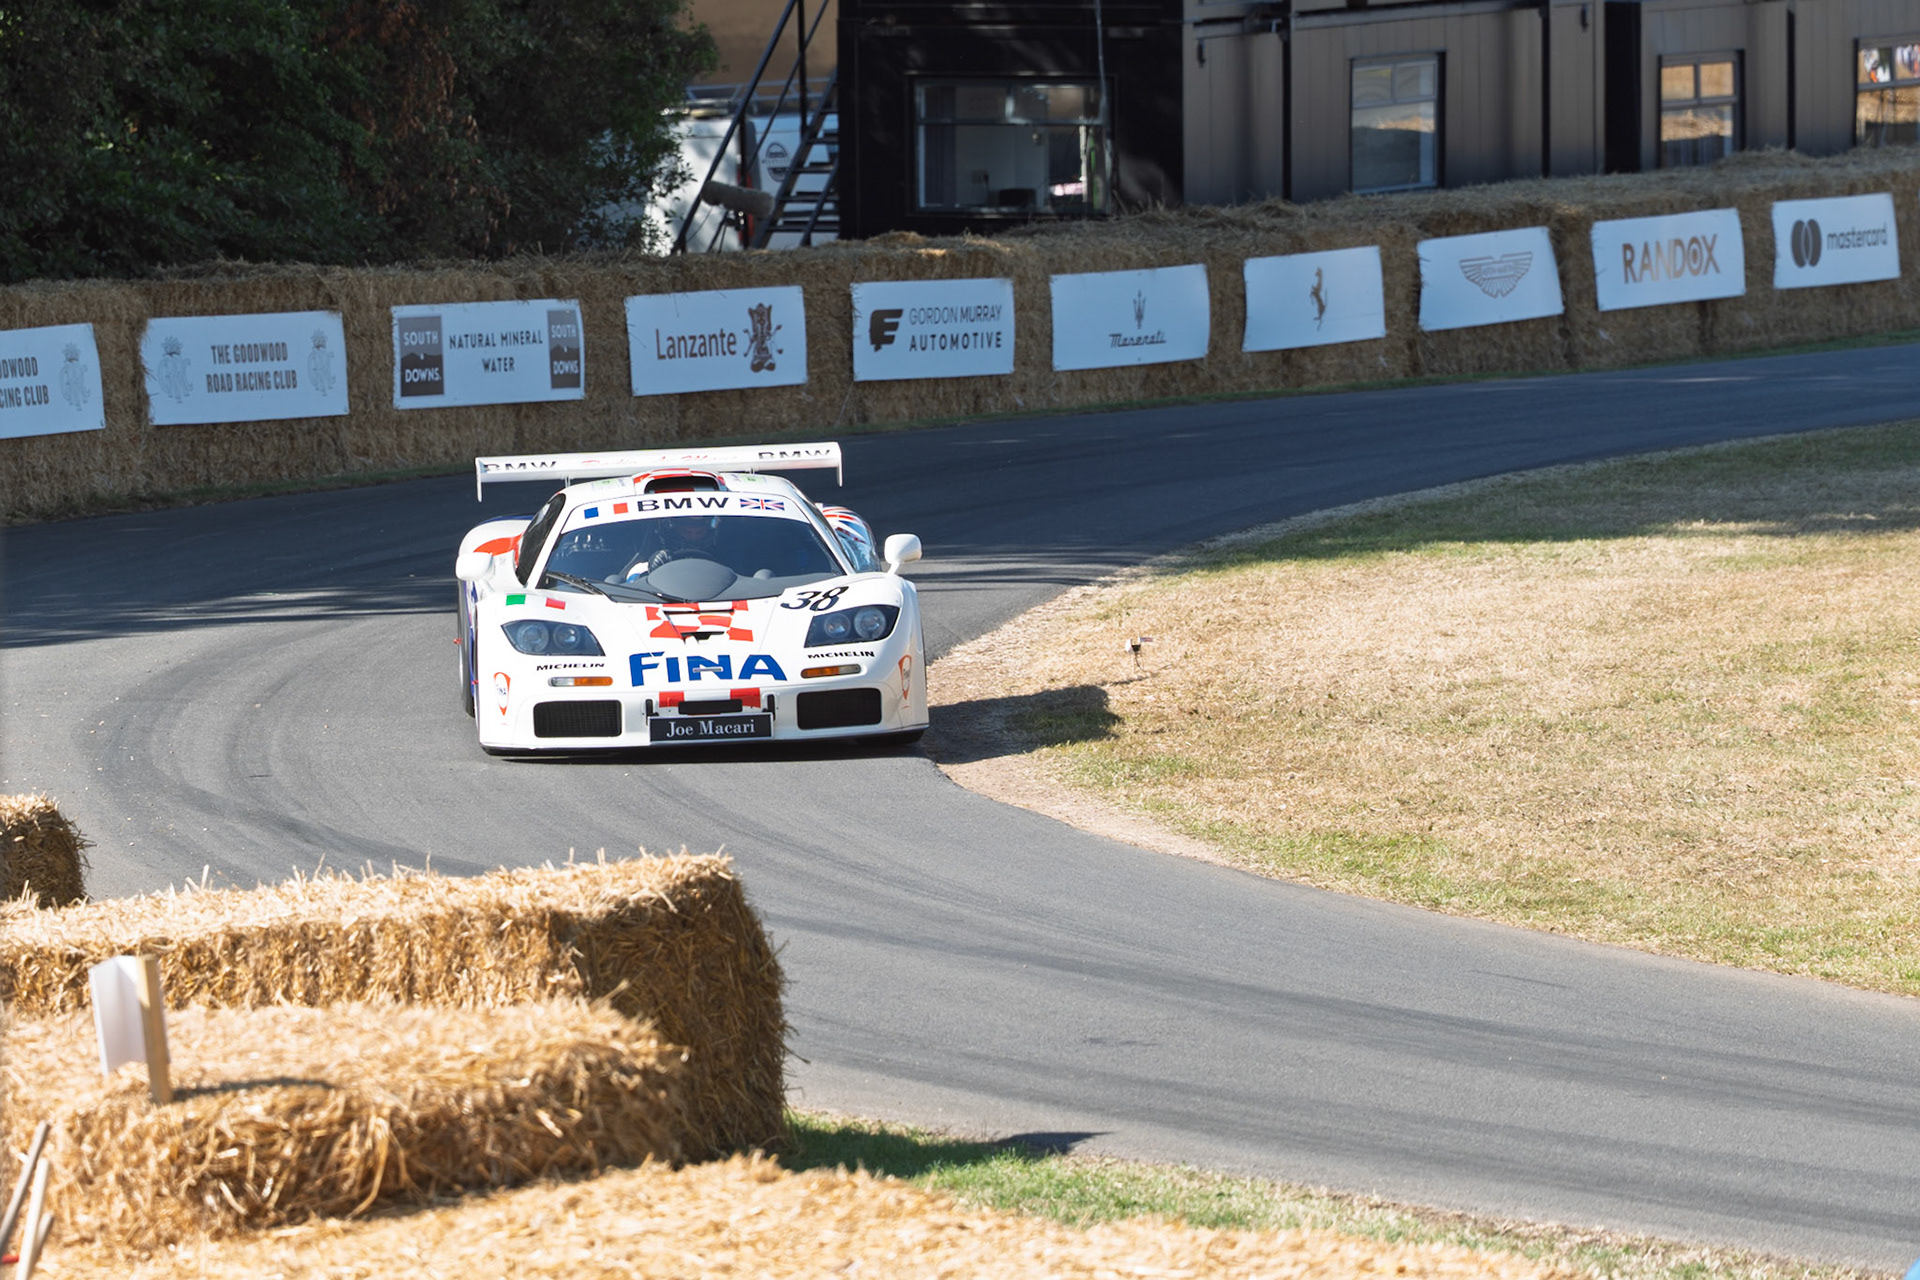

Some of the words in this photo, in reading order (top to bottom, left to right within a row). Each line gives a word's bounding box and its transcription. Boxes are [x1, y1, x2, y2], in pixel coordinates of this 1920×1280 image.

[1826, 222, 1887, 250] mastercard
[1622, 233, 1721, 284] RANDOX
[909, 306, 958, 325] GORDON
[960, 304, 1002, 322] MURRAY
[404, 330, 439, 346] SOUTH
[450, 333, 497, 349] NATURAL
[501, 330, 543, 346] MINERAL
[551, 324, 577, 338] SOUTH
[909, 331, 1002, 352] AUTOMOTIVE
[210, 344, 231, 364] THE
[233, 342, 288, 363] GOODWOOD
[655, 328, 737, 360] Lanzante
[482, 356, 515, 373] WATER
[206, 373, 233, 393] ROAD
[235, 371, 271, 391] RACING
[274, 370, 298, 390] CLUB
[24, 384, 49, 406] CLUB
[637, 497, 730, 512] BMW
[780, 586, 849, 612] 38
[807, 651, 875, 659] MICHELIN
[536, 663, 605, 671] MICHELIN
[629, 651, 788, 687] FINA
[666, 721, 694, 738] Joe
[699, 719, 756, 736] Macari
